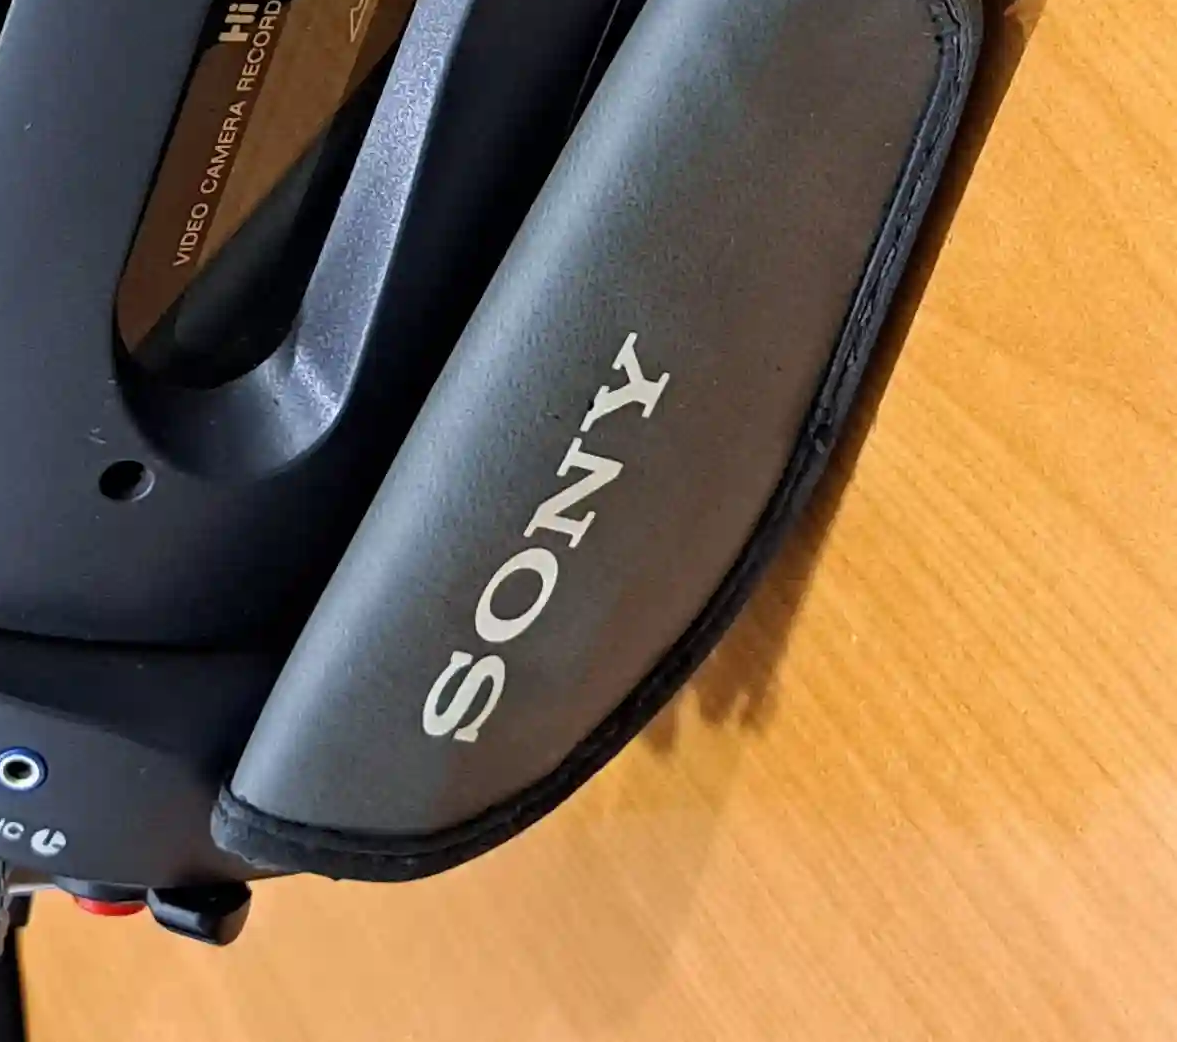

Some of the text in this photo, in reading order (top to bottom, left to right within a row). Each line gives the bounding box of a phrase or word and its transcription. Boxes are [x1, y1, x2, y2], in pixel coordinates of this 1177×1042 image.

[173, 202, 209, 266] VIDEO
[199, 99, 246, 195] CAMERA
[421, 330, 671, 744] SONY
